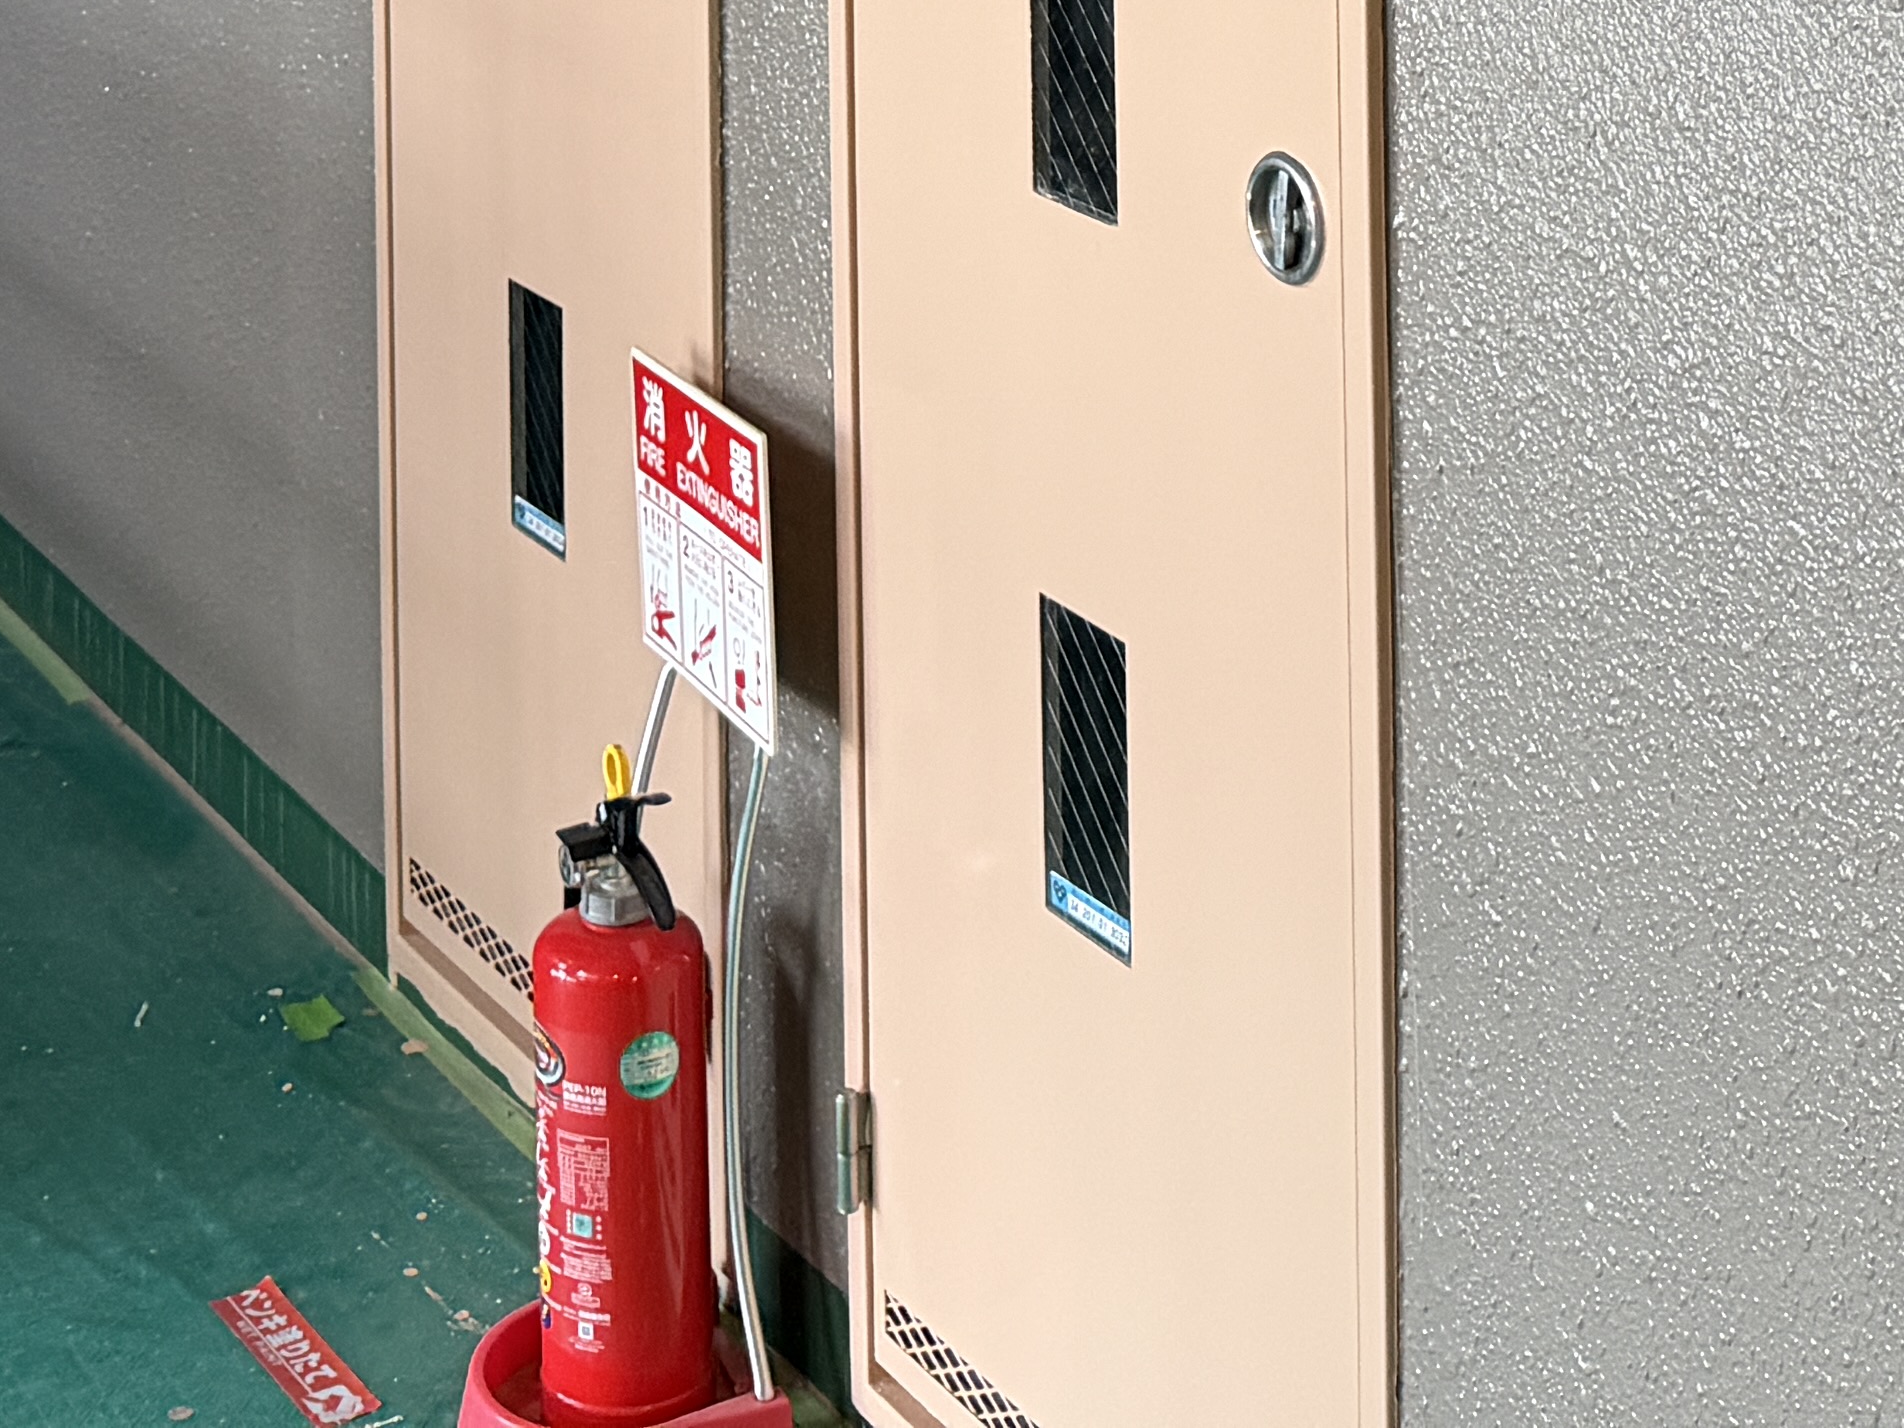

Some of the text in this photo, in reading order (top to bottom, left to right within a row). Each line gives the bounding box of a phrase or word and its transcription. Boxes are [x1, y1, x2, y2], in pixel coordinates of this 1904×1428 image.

[639, 434, 667, 478] FIRE
[676, 461, 762, 549] EXTINGUISHER
[641, 375, 754, 507] 消火器
